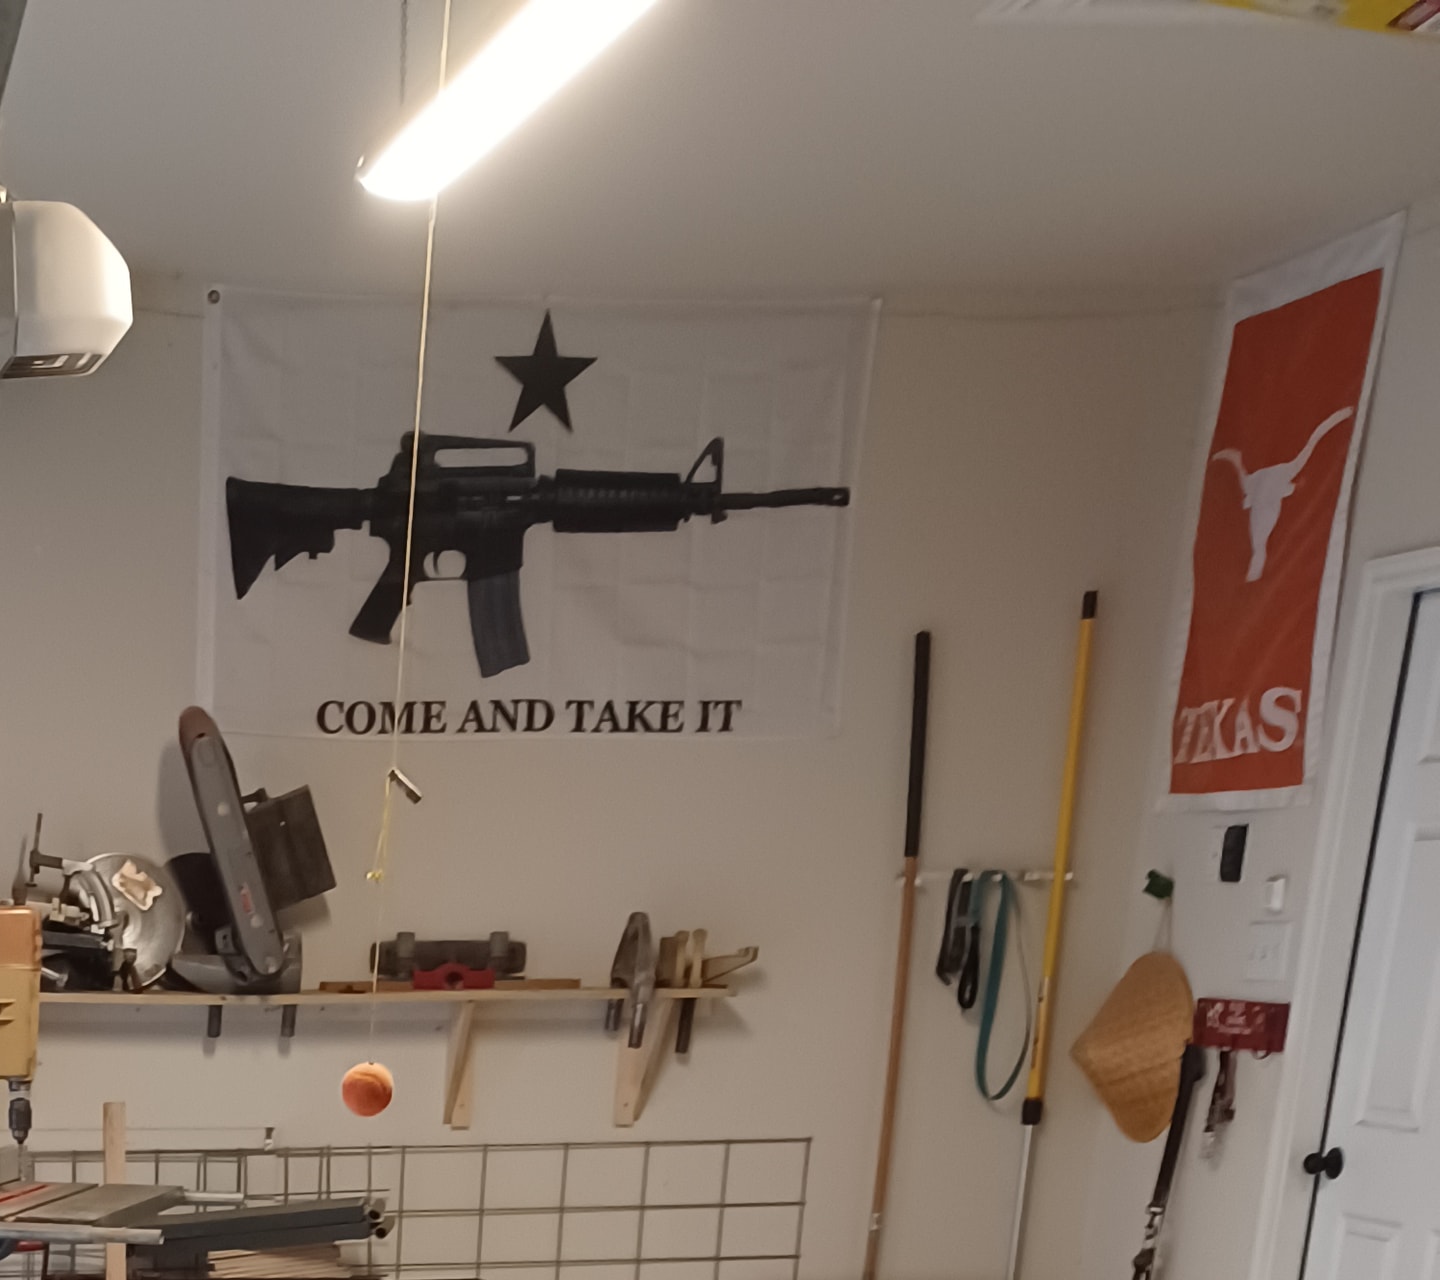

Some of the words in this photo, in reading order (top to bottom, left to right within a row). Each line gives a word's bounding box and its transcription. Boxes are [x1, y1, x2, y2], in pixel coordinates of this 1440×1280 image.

[316, 699, 448, 735] COME
[455, 698, 555, 734] AND
[564, 699, 686, 734] TAKE
[694, 699, 743, 734] IT
[1173, 686, 1302, 765] TEXAS
